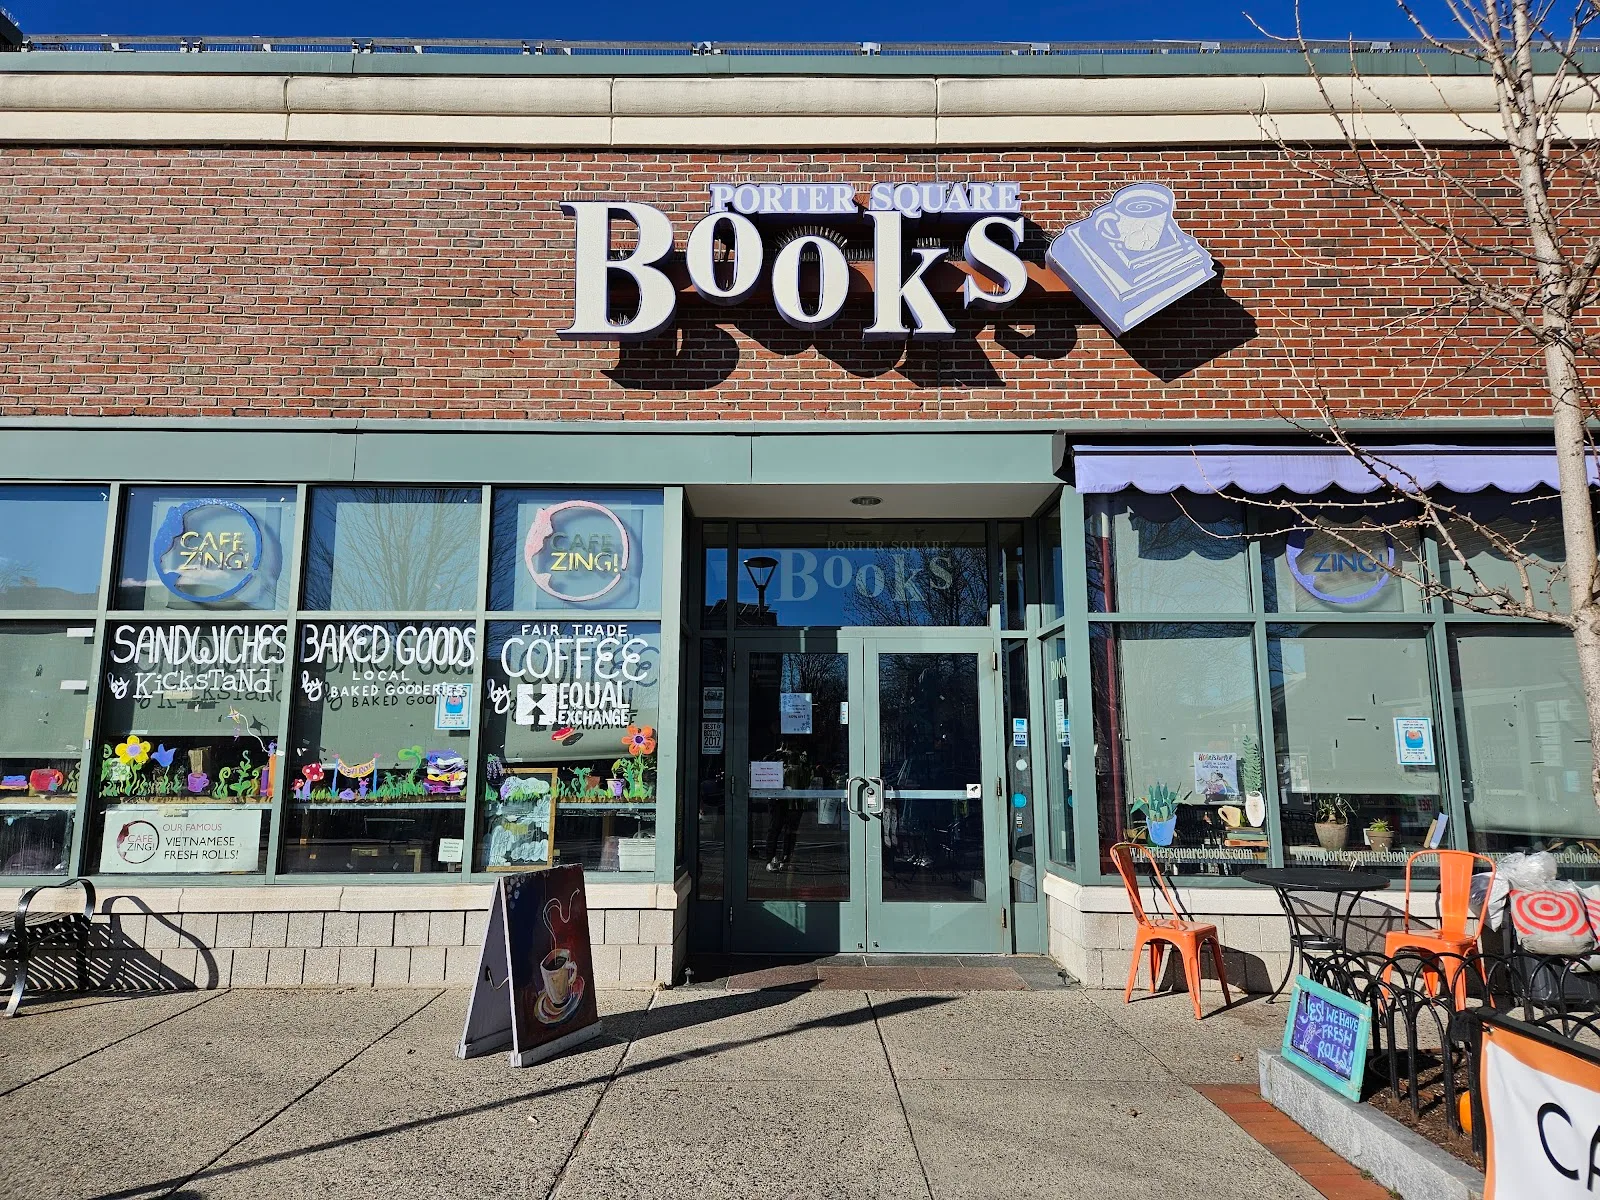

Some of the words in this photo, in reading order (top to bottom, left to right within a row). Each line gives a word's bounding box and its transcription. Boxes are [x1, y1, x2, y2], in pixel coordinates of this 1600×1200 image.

[710, 184, 858, 214] PORTER
[870, 183, 1021, 217] SQUARE
[557, 201, 1027, 338] Books
[181, 531, 244, 551] CAFE
[551, 532, 613, 552] CAFE
[827, 540, 884, 551] PORTER
[892, 540, 951, 552] SQUARE
[180, 551, 250, 570] ZING!
[550, 552, 619, 572] ZING!
[1313, 553, 1384, 572] ZING!
[775, 549, 953, 602] Books
[521, 624, 559, 636] FAIR
[572, 624, 628, 637] TRADE
[110, 624, 287, 665] SANDWICHES
[300, 624, 390, 664] BAKED
[396, 626, 476, 667] GOODS
[501, 638, 649, 681] COFFEE
[301, 670, 324, 701] by
[331, 685, 380, 698] BAKED
[352, 670, 410, 681] LOCAL
[107, 672, 130, 700] by
[558, 681, 631, 710] EQUAL
[486, 678, 511, 714] by
[558, 709, 631, 725] EXCHANGE
[704, 737, 721, 746] 2017
[162, 824, 183, 832] OUR
[185, 823, 222, 832] FAMOUS
[126, 842, 155, 852] ZING!
[127, 834, 153, 843] CAFE
[165, 836, 236, 847] VIETNAMESE
[164, 850, 198, 860] FRESH
[201, 849, 239, 860] ROLLS!
[1321, 1024, 1352, 1047] FRESH
[1317, 1041, 1354, 1073] ROLLS!
